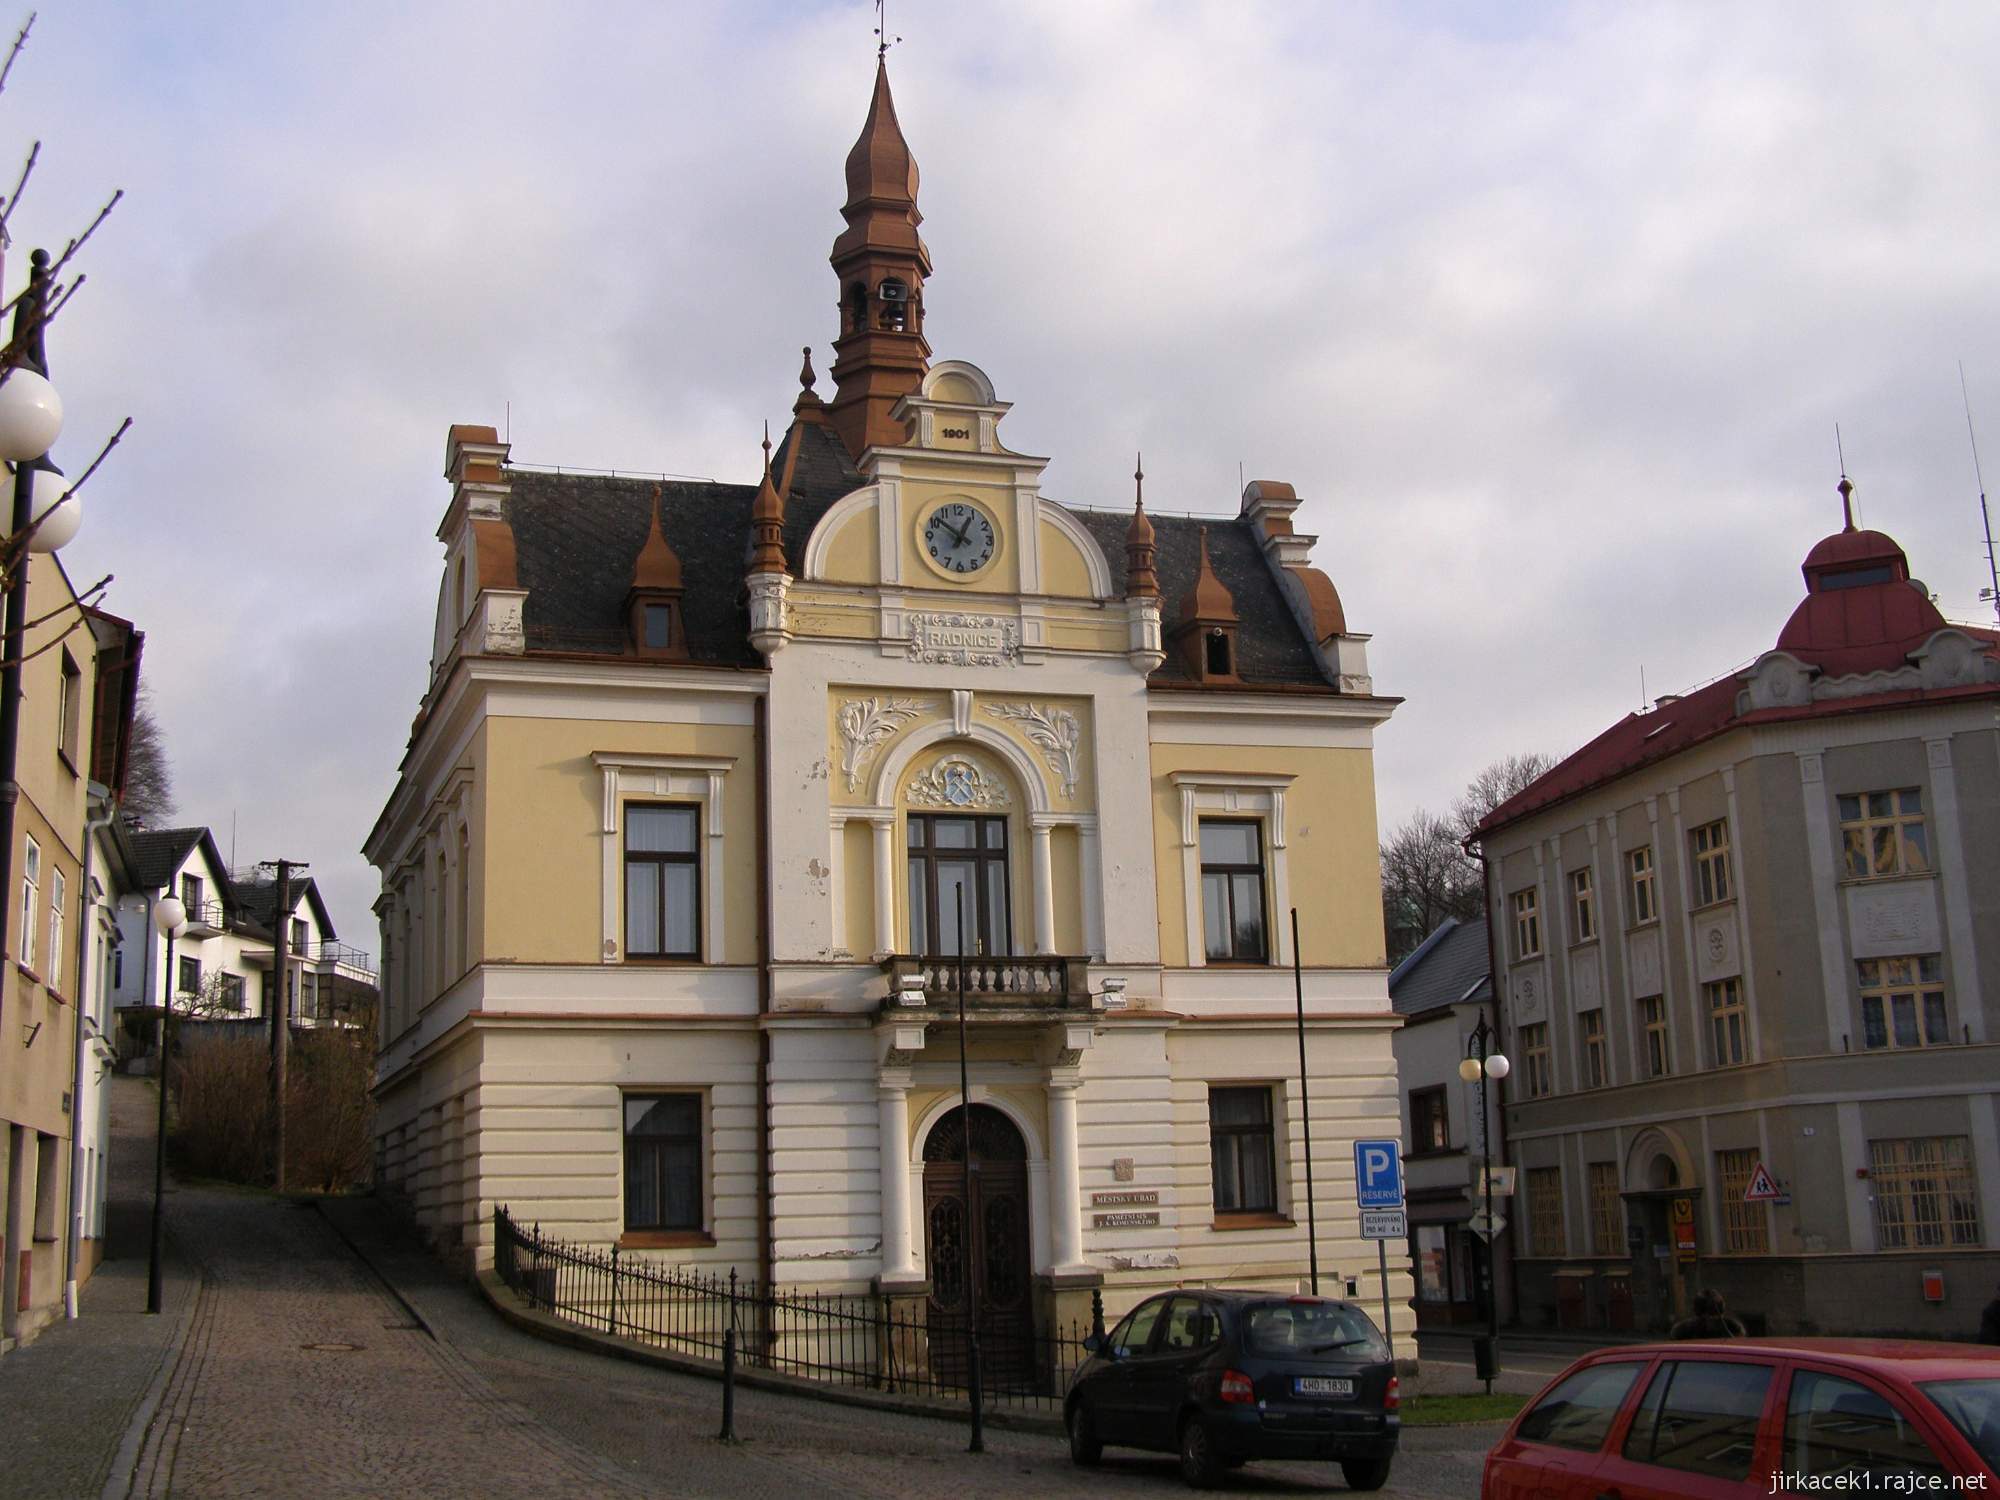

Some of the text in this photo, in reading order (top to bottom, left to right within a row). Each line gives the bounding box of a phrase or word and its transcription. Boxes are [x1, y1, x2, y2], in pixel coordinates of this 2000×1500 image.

[942, 428, 970, 440] 1901
[941, 507, 948, 519] 11
[953, 505, 964, 516] 12
[930, 516, 941, 529] 10
[981, 520, 989, 532] 2
[925, 531, 934, 542] 9
[985, 535, 993, 546] 3
[930, 546, 938, 557] 8
[981, 550, 988, 560] 4
[944, 557, 952, 568] 7
[956, 561, 964, 572] 6
[970, 559, 978, 570] 5
[929, 632, 997, 648] RADNICE
[1365, 1149, 1390, 1186] P
